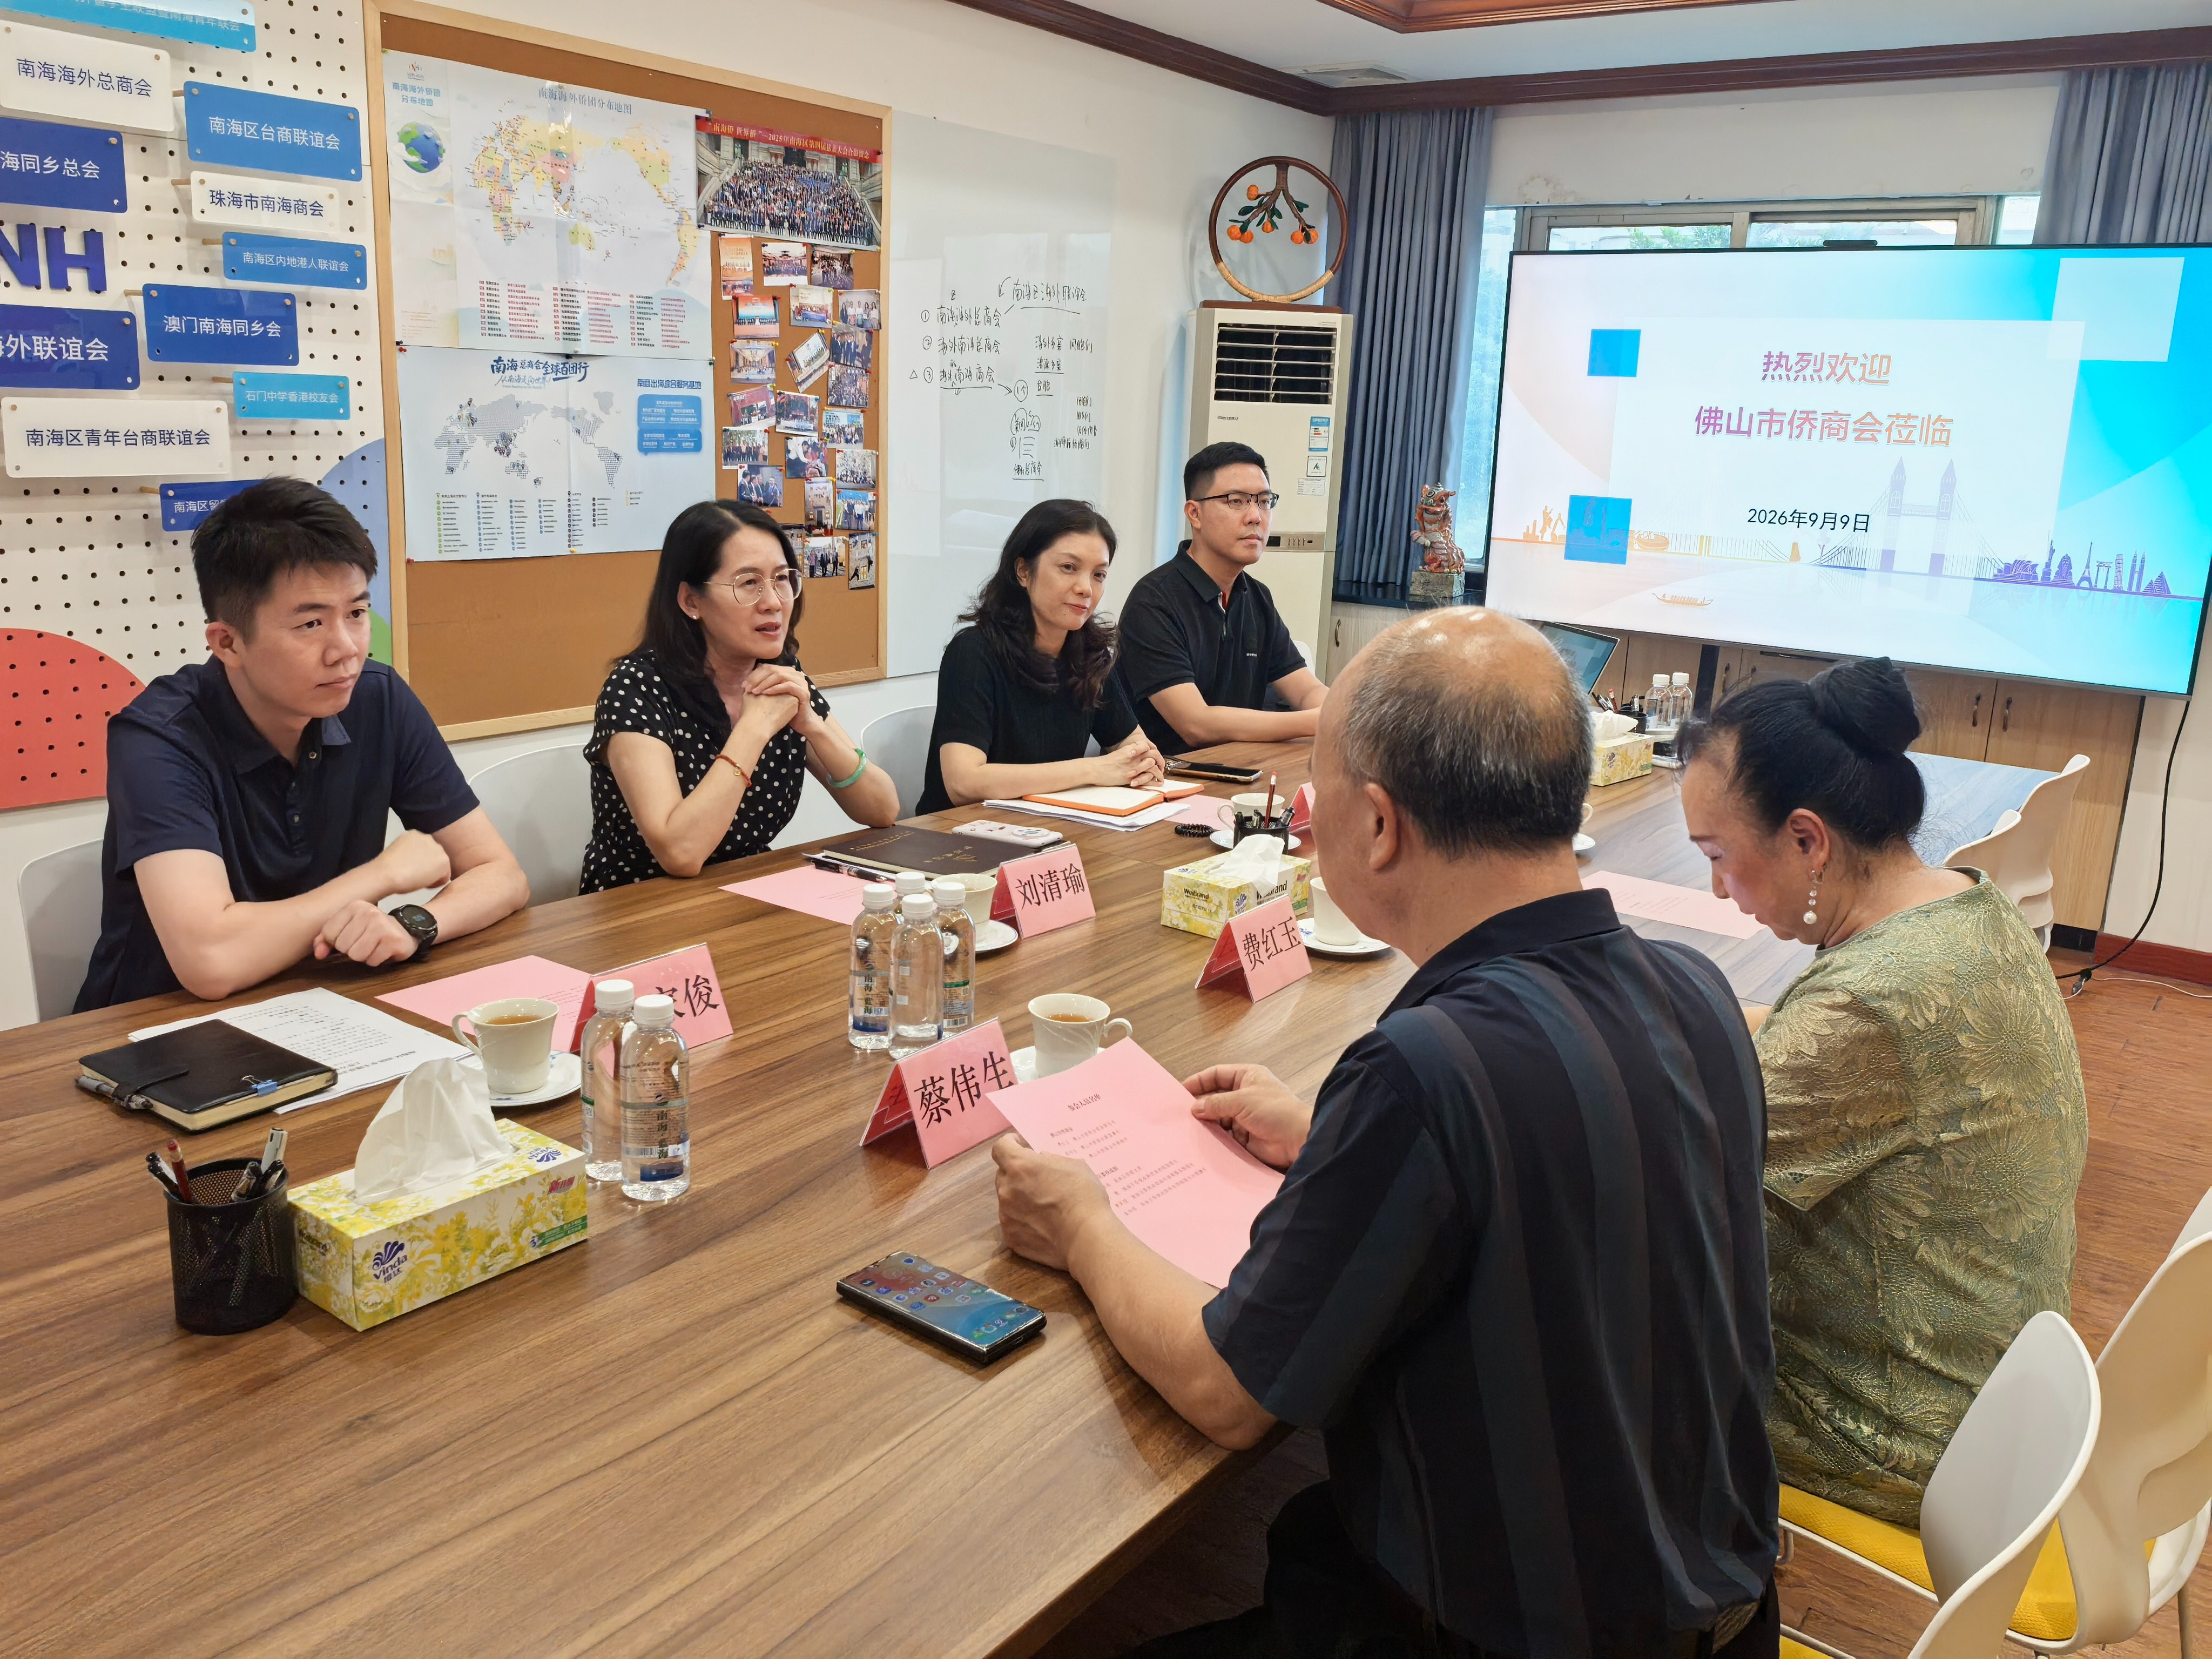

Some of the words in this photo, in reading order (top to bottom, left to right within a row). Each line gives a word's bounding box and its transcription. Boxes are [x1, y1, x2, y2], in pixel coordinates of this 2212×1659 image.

[17, 58, 152, 97] 南海海外总商会
[208, 116, 340, 151] 南海区台商联谊会
[0, 151, 99, 179] 海同乡总会
[209, 190, 324, 218] 珠海市南海商会
[0, 224, 107, 292] NH
[242, 252, 349, 272] 南海区内地港人联谊会
[163, 315, 281, 338] 澳门南海同乡会
[1762, 350, 1892, 385] 热烈欢迎
[246, 391, 339, 404] 石门中学香港校友会
[26, 428, 211, 447] 南海区青年台商联谊会
[1695, 405, 1954, 447] 佛山市侨商会莅临
[173, 499, 226, 513] 南海区留
[1747, 508, 1869, 533] 2026年9月9日
[1015, 862, 1085, 911] 刘清瑜
[1243, 916, 1301, 972] 费红玉
[914, 1051, 1015, 1128] 蔡伟生
